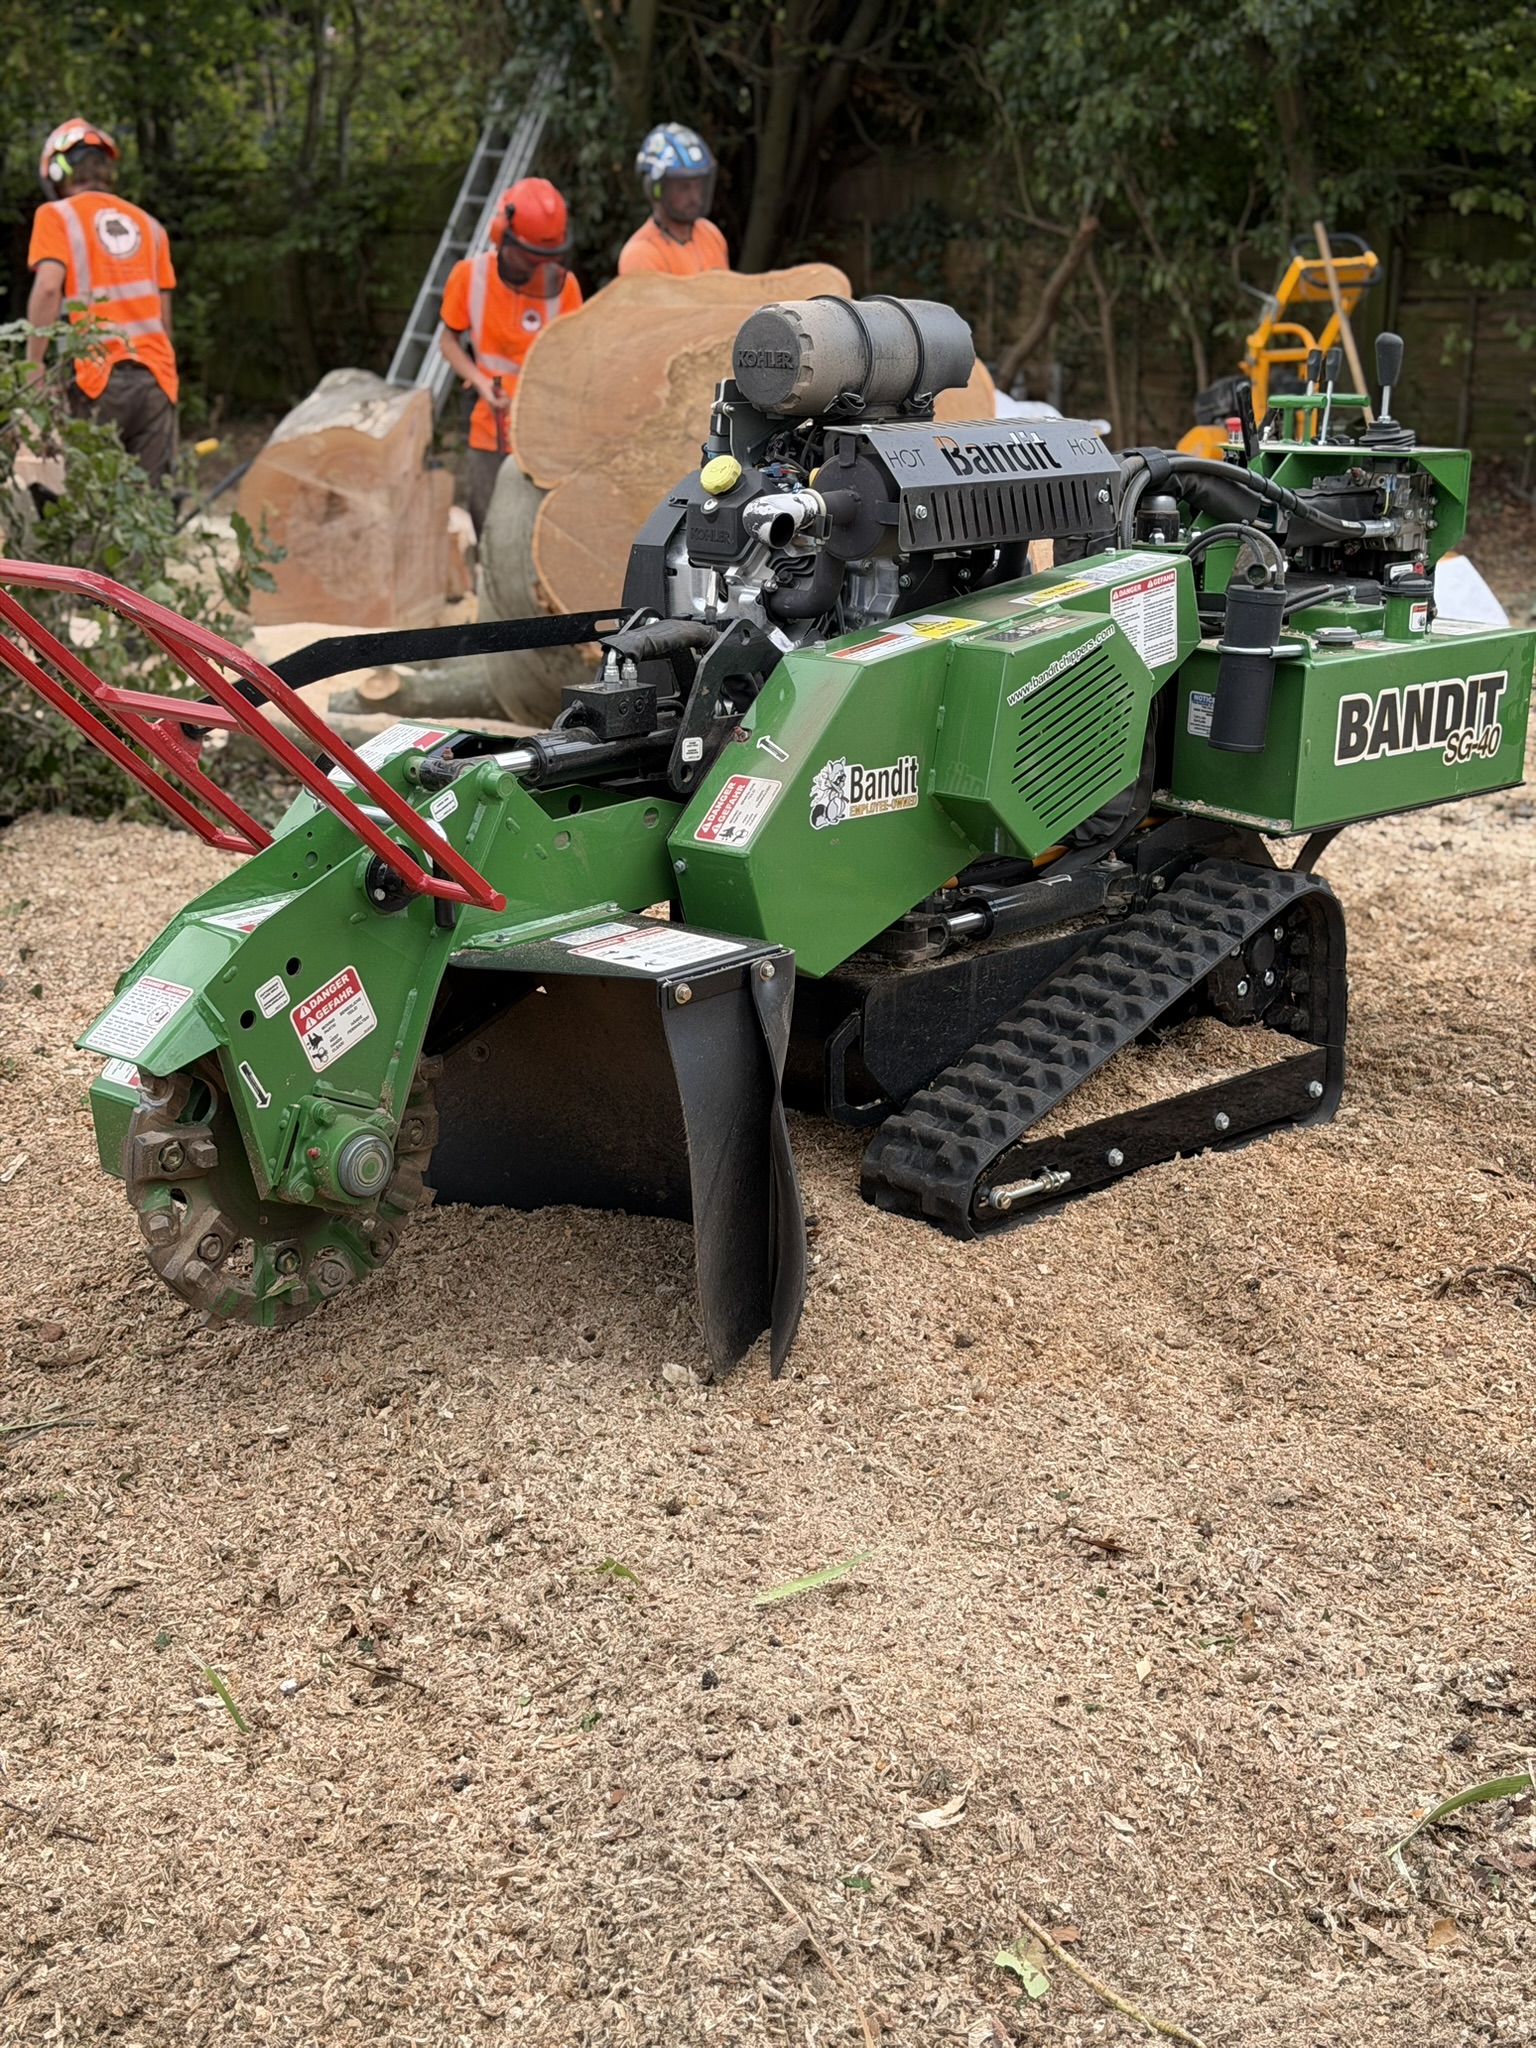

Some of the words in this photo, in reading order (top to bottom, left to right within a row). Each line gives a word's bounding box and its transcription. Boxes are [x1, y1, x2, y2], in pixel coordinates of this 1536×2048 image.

[737, 350, 795, 370] KOHLER
[885, 447, 926, 469] HOT
[932, 430, 1063, 477] Bandit
[1066, 437, 1104, 456] HOT
[689, 526, 733, 545] KOHLER
[1118, 584, 1142, 597] DANGER
[1153, 572, 1175, 586] GEFAHR
[1007, 625, 1115, 706] www.banditchippers.com
[1337, 675, 1505, 761] BANDIT
[1444, 725, 1501, 763] SG-40
[850, 757, 917, 803] Bandit
[707, 781, 737, 822] DANGER
[718, 784, 746, 823] GEFAHR
[849, 795, 918, 817] EMPLOYEE-OWNED
[309, 973, 350, 1010] DANGER
[315, 985, 354, 1020] GEFAHR
